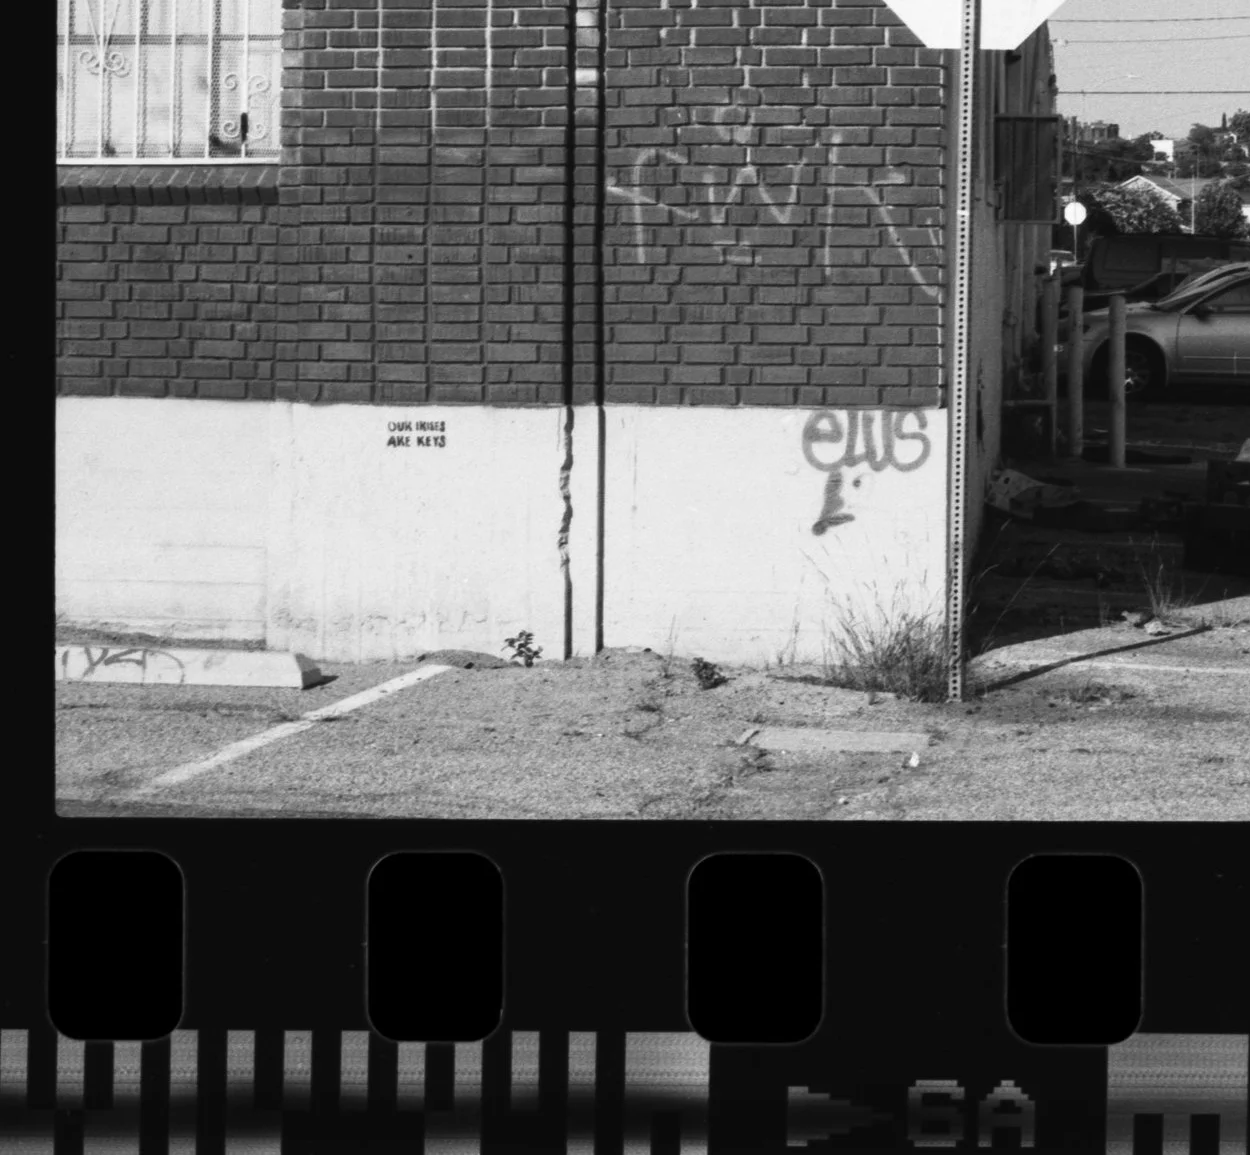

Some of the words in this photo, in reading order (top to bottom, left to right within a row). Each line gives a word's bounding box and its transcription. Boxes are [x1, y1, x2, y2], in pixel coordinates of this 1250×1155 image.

[387, 421, 413, 432] OUR
[387, 436, 411, 448] ARE
[416, 435, 446, 448] KEYS
[907, 1079, 1036, 1148] 6A
